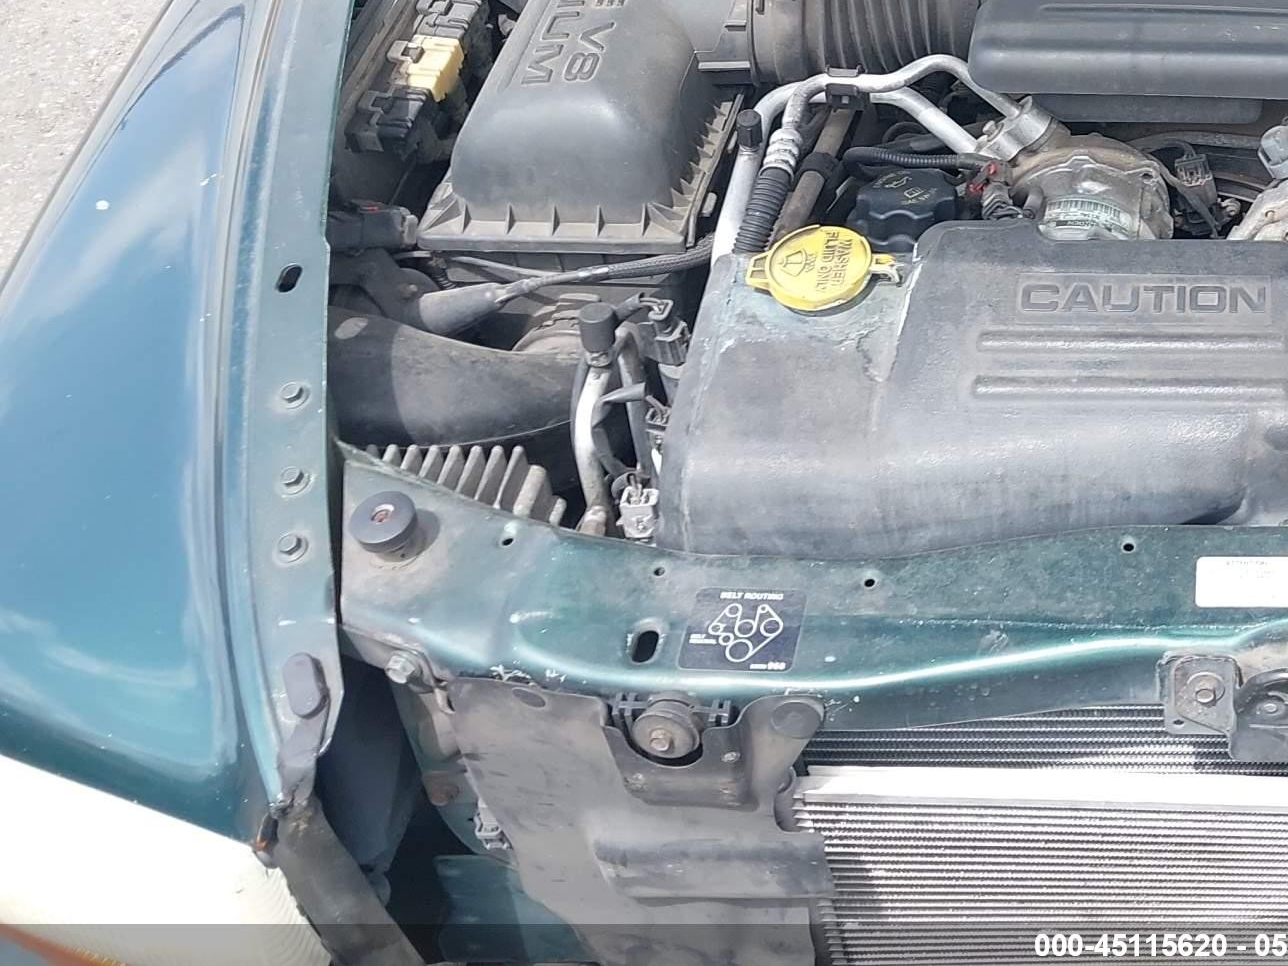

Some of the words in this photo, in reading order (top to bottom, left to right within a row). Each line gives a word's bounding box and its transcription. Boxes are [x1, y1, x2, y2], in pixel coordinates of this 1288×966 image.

[563, 21, 616, 82] V8
[822, 231, 840, 263] FLUID
[831, 238, 854, 287] WASHER
[1020, 283, 1267, 314] CAUTION
[720, 591, 744, 599] BELT
[744, 592, 785, 601] ROUTING
